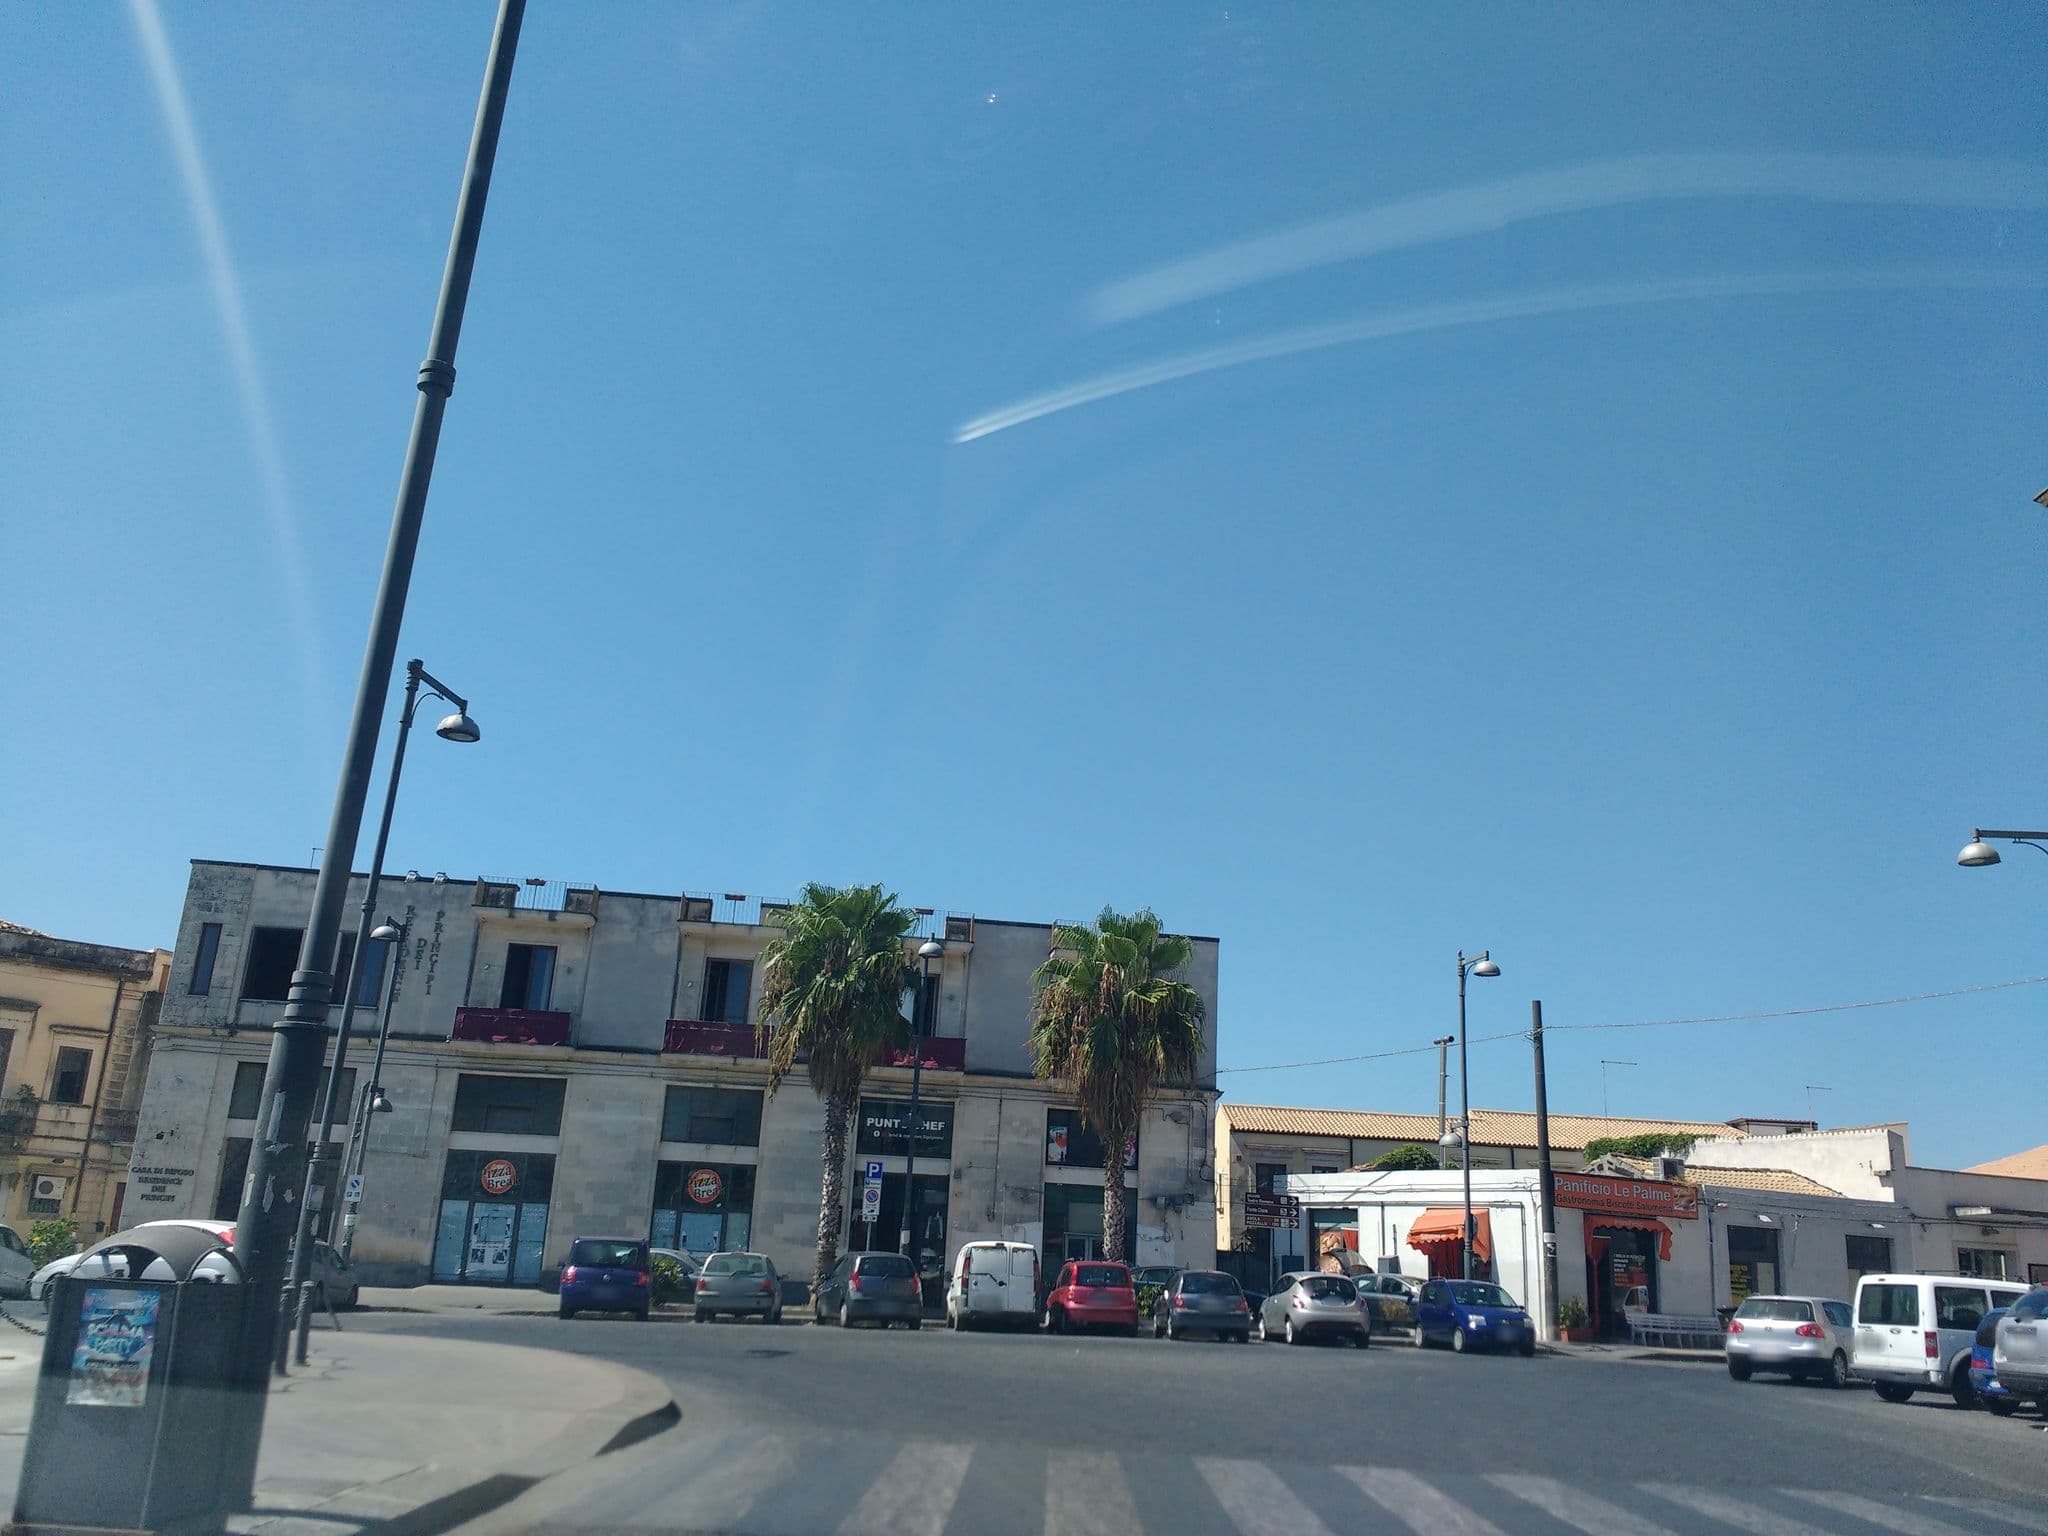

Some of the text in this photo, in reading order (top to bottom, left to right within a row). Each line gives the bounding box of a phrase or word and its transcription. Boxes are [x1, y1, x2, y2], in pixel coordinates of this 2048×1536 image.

[415, 938, 427, 970] DEI
[426, 911, 445, 995] PRINCIPI
[867, 1118, 945, 1131] PUNT HEF
[868, 1163, 879, 1177] P
[488, 1179, 515, 1188] Brea
[1554, 1177, 1672, 1202] Panificio Le Palme
[1556, 1194, 1604, 1206] Gastronomia
